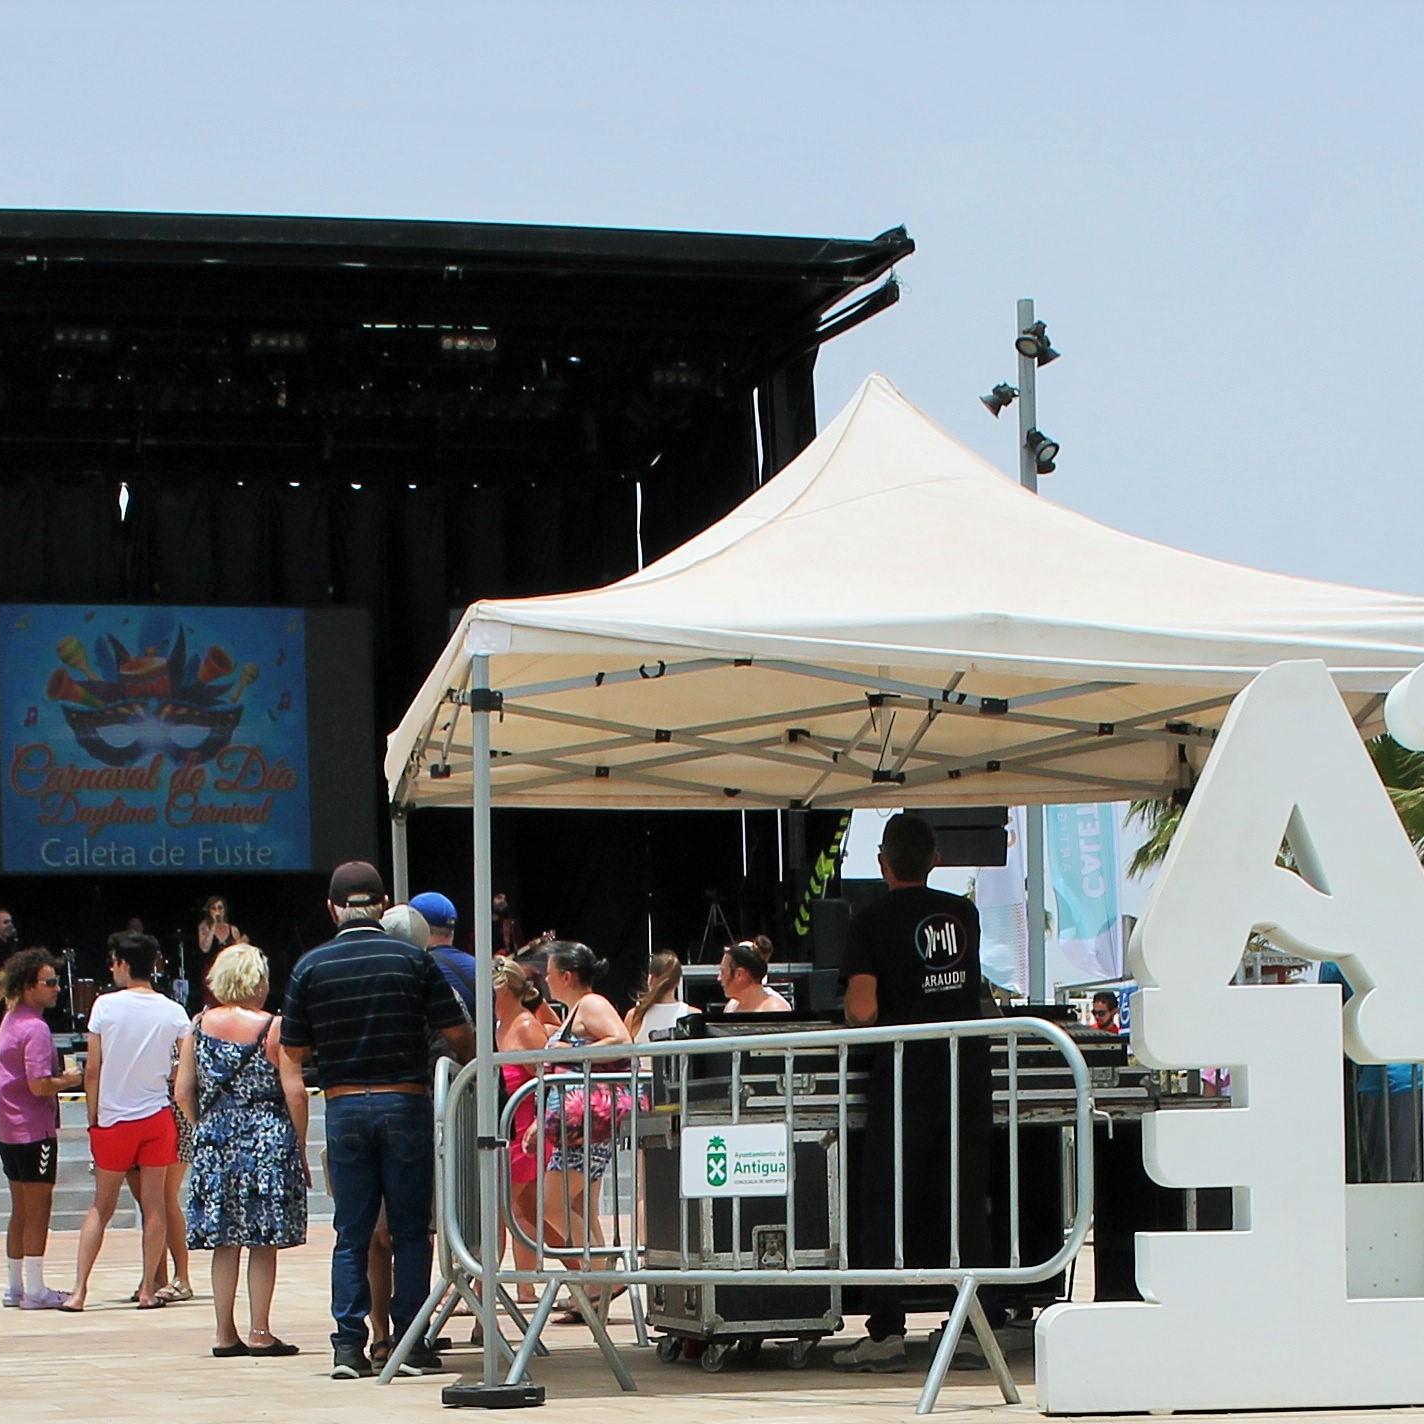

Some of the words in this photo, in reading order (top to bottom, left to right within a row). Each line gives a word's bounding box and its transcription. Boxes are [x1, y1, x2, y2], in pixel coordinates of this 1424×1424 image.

[10, 742, 164, 796] Carnaval
[169, 752, 207, 790] de
[40, 838, 136, 867] Caleta
[148, 838, 185, 866] de
[198, 838, 273, 867] Fuste
[734, 1160, 786, 1177] Antigua
